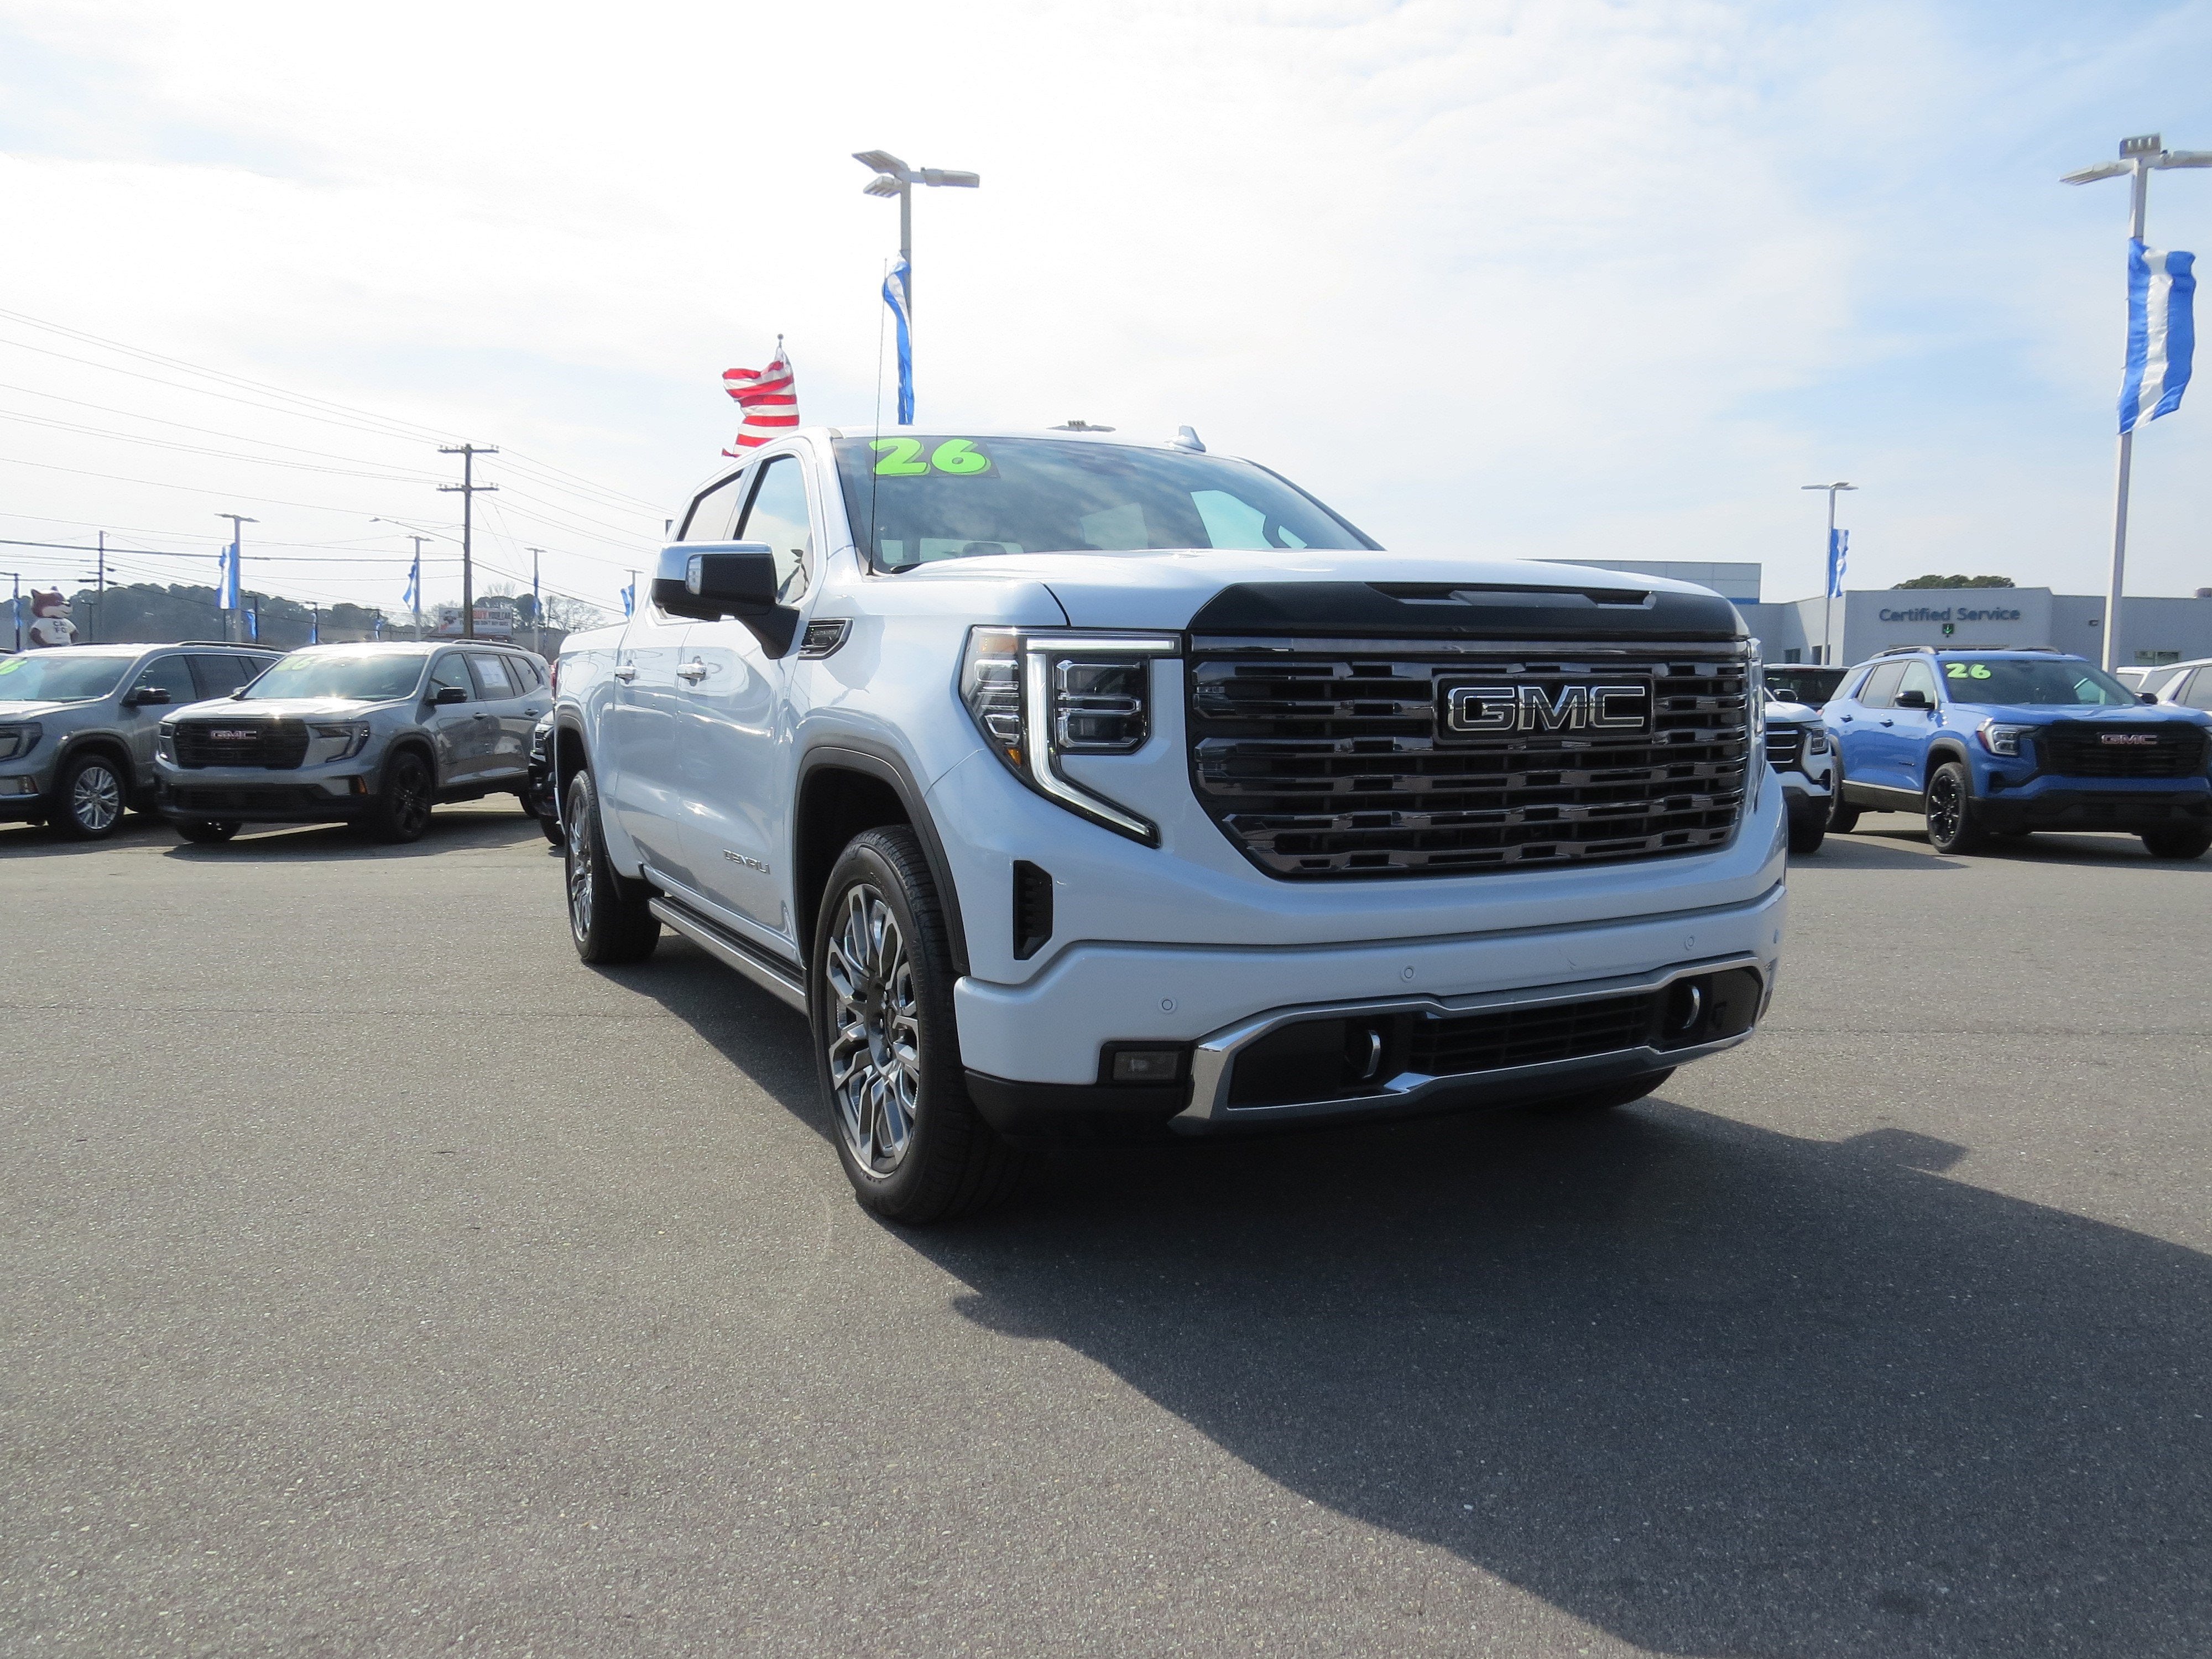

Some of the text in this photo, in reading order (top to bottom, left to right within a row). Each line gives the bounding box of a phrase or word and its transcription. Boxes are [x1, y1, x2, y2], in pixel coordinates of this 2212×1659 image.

[868, 437, 992, 476] 26
[1879, 607, 2020, 622] Certified Service
[1945, 662, 1991, 679] 26
[1448, 685, 1646, 732] GMC
[211, 730, 257, 739] GMC
[2101, 734, 2157, 745] GMC
[722, 848, 770, 874] DENALI
